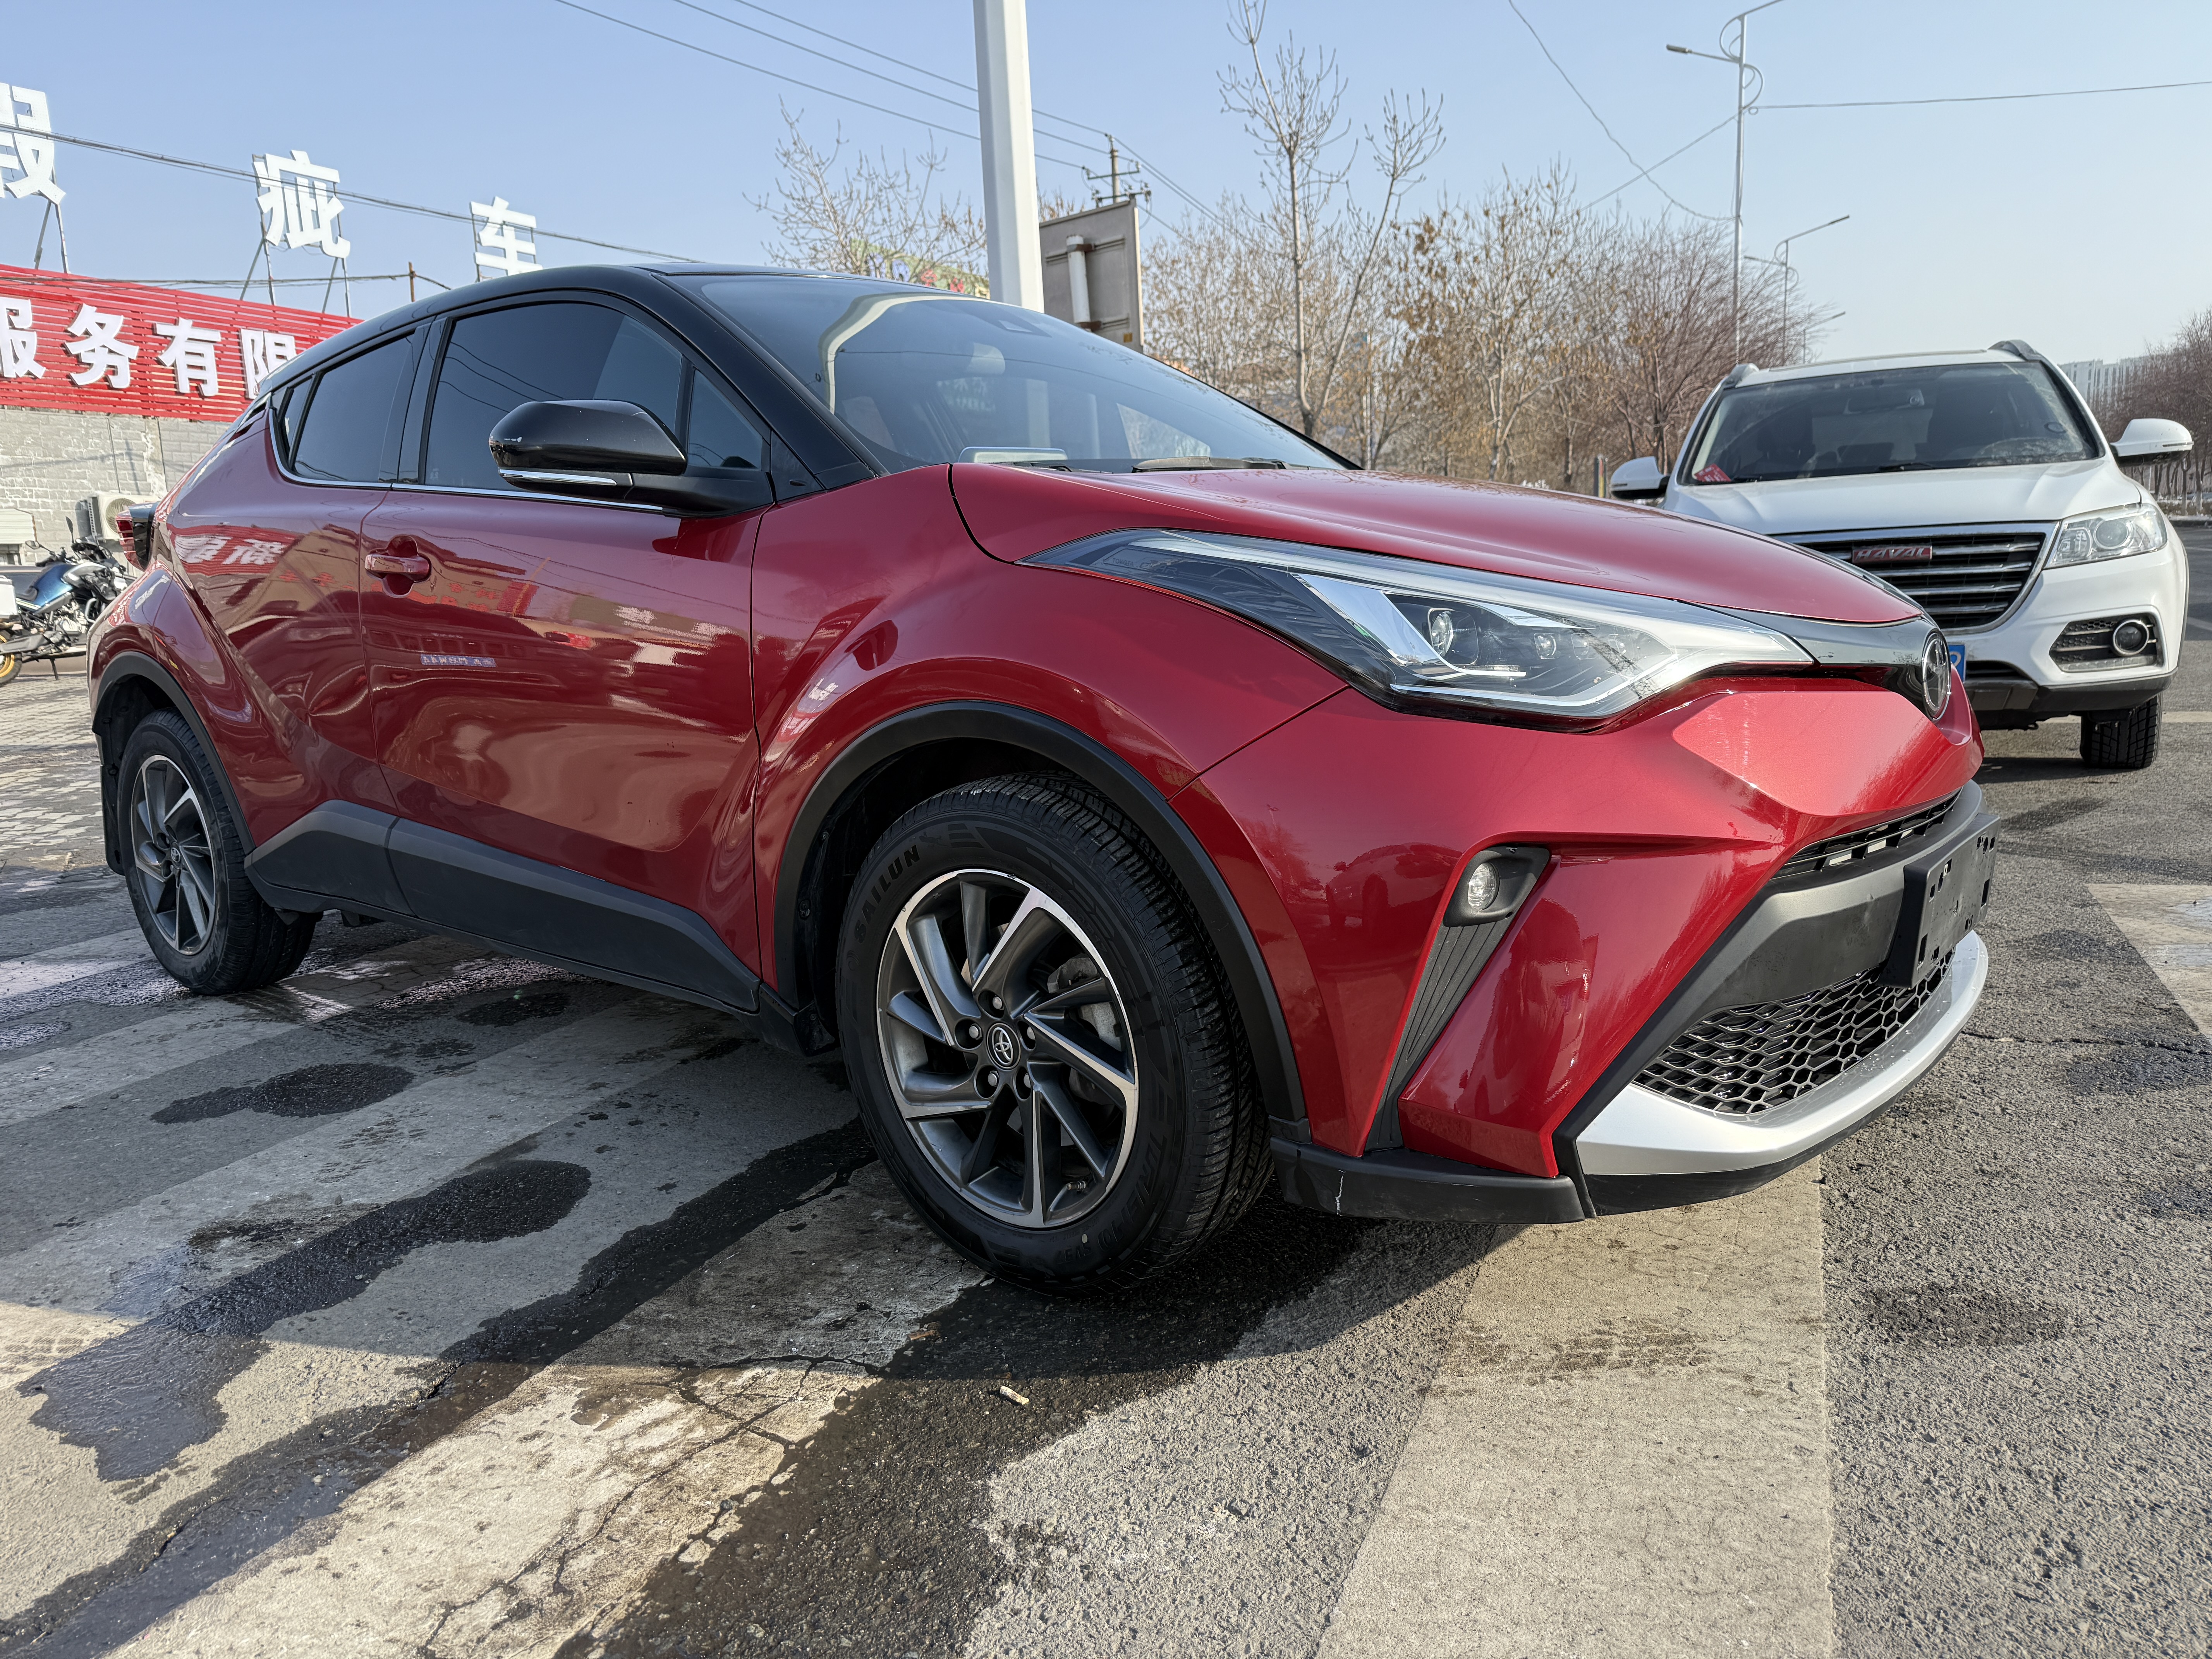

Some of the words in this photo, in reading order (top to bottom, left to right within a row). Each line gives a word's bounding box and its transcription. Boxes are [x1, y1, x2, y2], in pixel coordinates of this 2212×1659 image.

[0, 297, 297, 399] 服务有限
[1855, 547, 1930, 560] HAVAL
[853, 840, 921, 946] SAILUN
